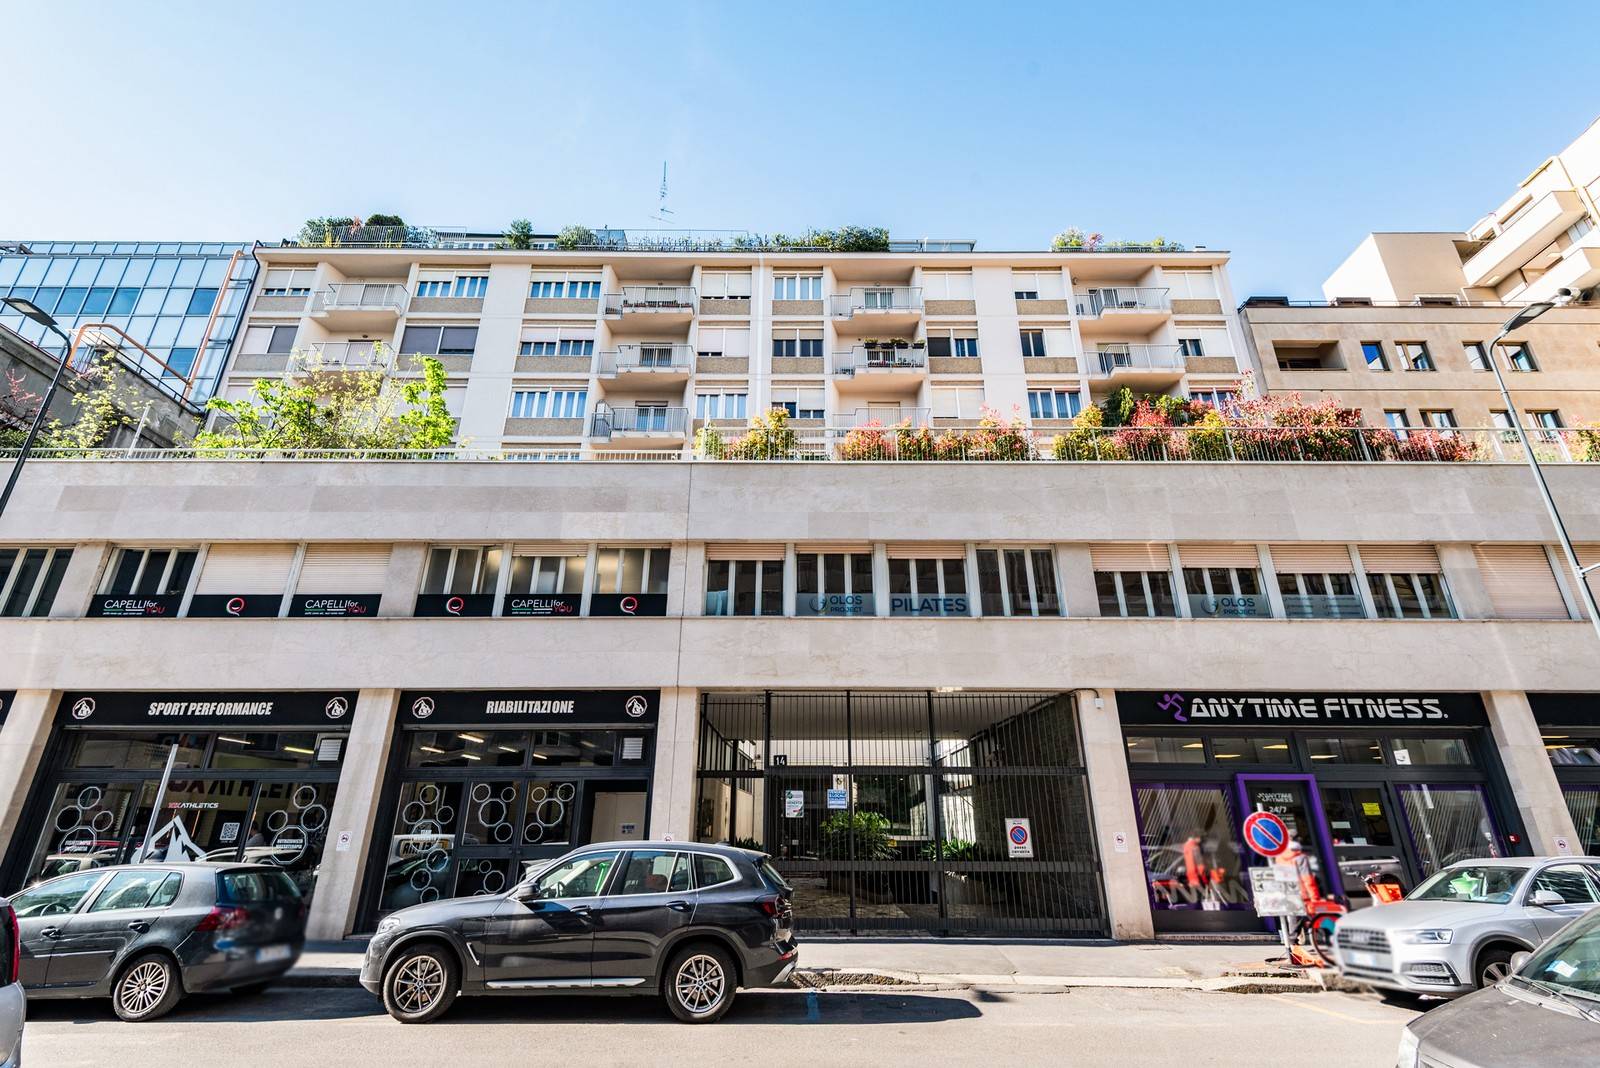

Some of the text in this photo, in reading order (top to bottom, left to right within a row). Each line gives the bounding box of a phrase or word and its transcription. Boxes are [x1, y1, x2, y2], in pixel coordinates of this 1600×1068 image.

[829, 595, 863, 605] OLOS
[891, 598, 967, 612] PILATES
[1221, 597, 1255, 607] OLOS
[1223, 608, 1257, 616] PROJECT
[147, 702, 274, 716] SPORT PERFORMANCE
[485, 700, 575, 714] RIABILITAZIONE
[1190, 697, 1319, 718] ANYTIME
[776, 756, 786, 766] 14
